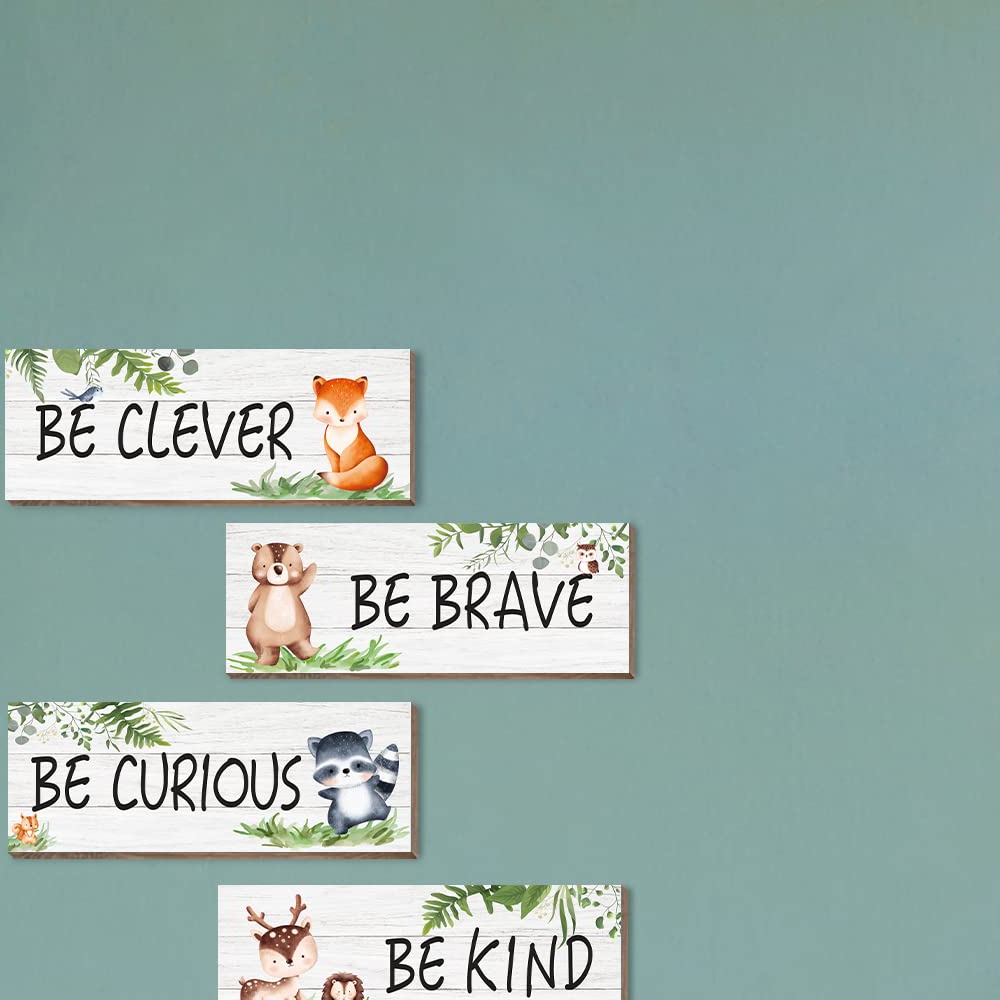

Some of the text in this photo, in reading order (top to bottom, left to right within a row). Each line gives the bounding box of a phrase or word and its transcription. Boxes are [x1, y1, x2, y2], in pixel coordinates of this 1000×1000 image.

[35, 400, 294, 461] BE CLEVER
[350, 570, 593, 632] BE BRAVE
[31, 752, 302, 812] BE CURIOUS
[385, 927, 593, 998] BE KIND
